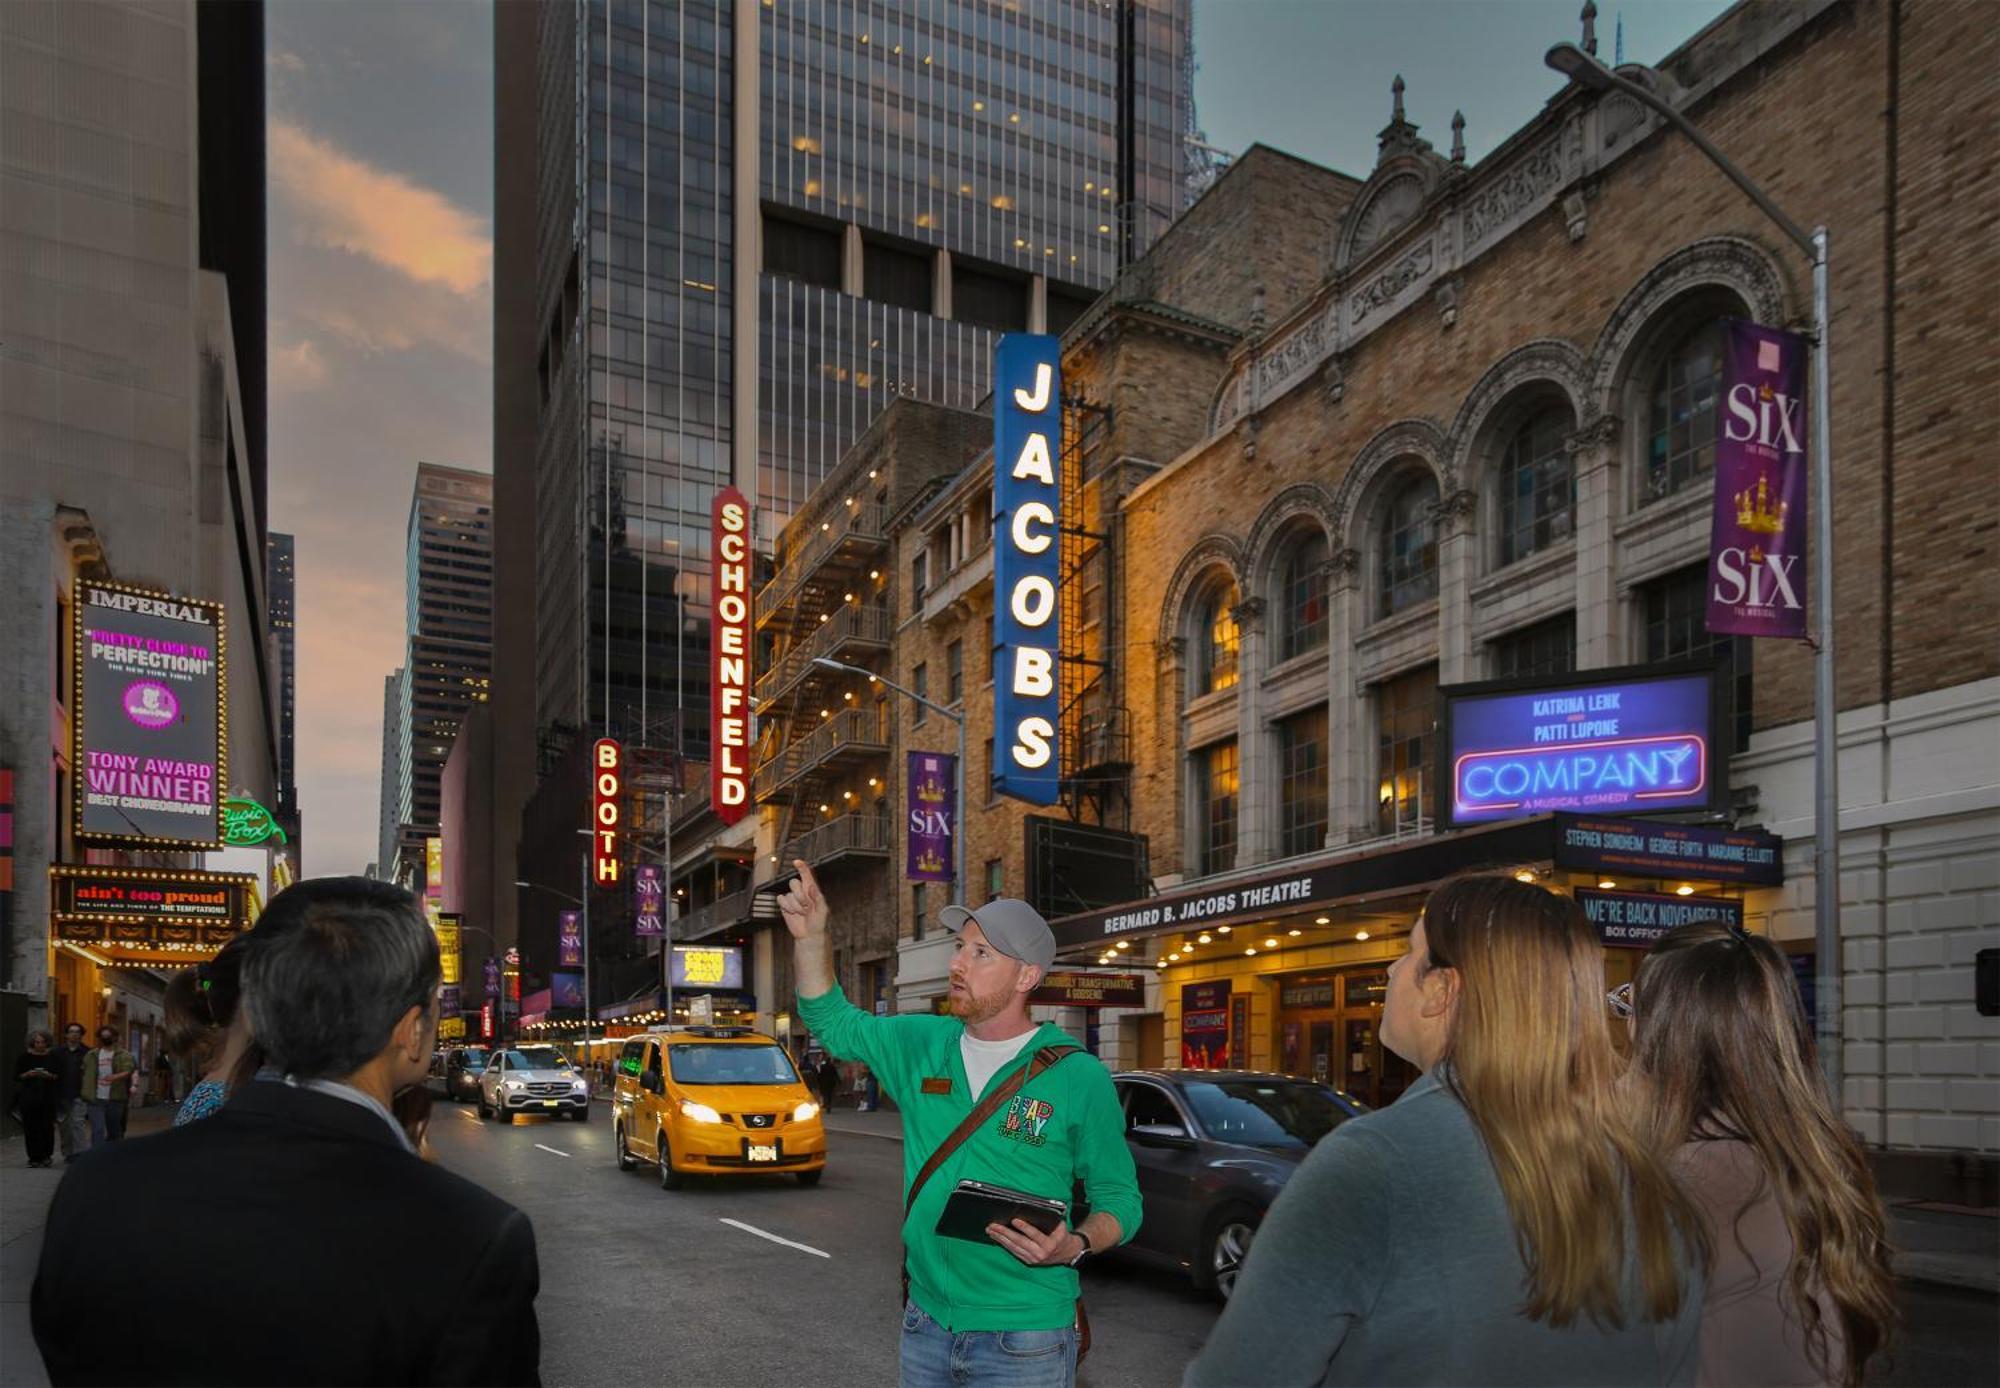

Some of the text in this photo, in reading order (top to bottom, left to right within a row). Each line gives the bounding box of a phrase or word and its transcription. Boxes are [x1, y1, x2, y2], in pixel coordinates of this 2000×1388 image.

[1012, 362, 1055, 769] JACOBS
[89, 589, 210, 625] IMPERIAL
[192, 646, 208, 660] TO
[719, 503, 746, 806] SCHOENFELD
[1533, 698, 1585, 717] KATRINA
[1589, 693, 1620, 711] LENK
[1534, 719, 1619, 742] PATTI LUPONE
[88, 752, 211, 779] TONY AWARD
[1465, 744, 1692, 797] COMPANY
[88, 768, 211, 803] WINNER
[1523, 792, 1629, 809] A MUSICAL COMEDY
[598, 745, 618, 881] BOOTH
[227, 821, 267, 839] Box
[1566, 829, 1600, 847] STEPHEN
[1603, 834, 1644, 851] SONDHEIM
[1649, 838, 1678, 855] GEORGE
[129, 890, 162, 901] too
[165, 891, 225, 904] proud
[176, 905, 226, 913] TEMPTATIONS
[1104, 878, 1311, 934] BERNARD B. JACOBS THEATRE
[1585, 899, 1623, 923] WE'RE
[1626, 902, 1656, 924] BACK
[1606, 926, 1626, 937] BOX
